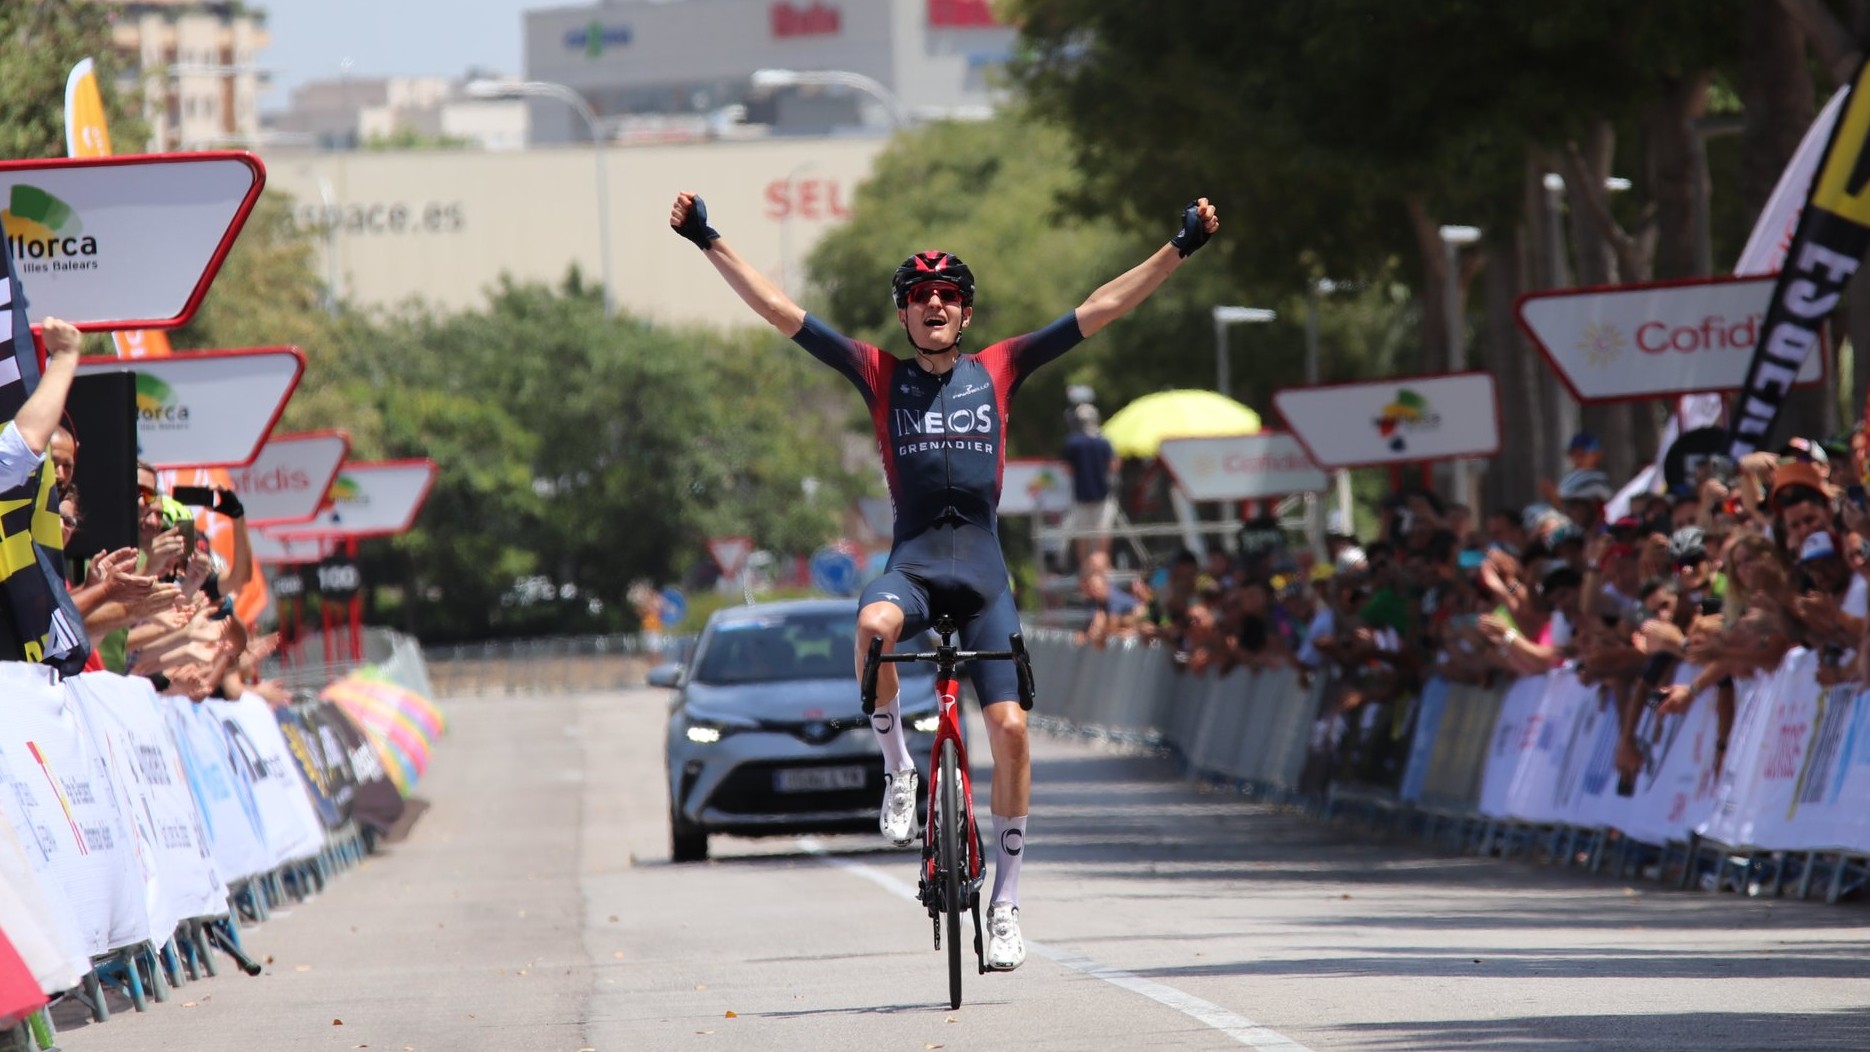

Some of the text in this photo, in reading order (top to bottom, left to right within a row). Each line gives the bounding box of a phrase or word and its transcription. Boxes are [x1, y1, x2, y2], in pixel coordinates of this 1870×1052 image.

[53, 259, 98, 271] Balears
[894, 404, 992, 437] INEOS
[899, 440, 993, 456] GRENADIER
